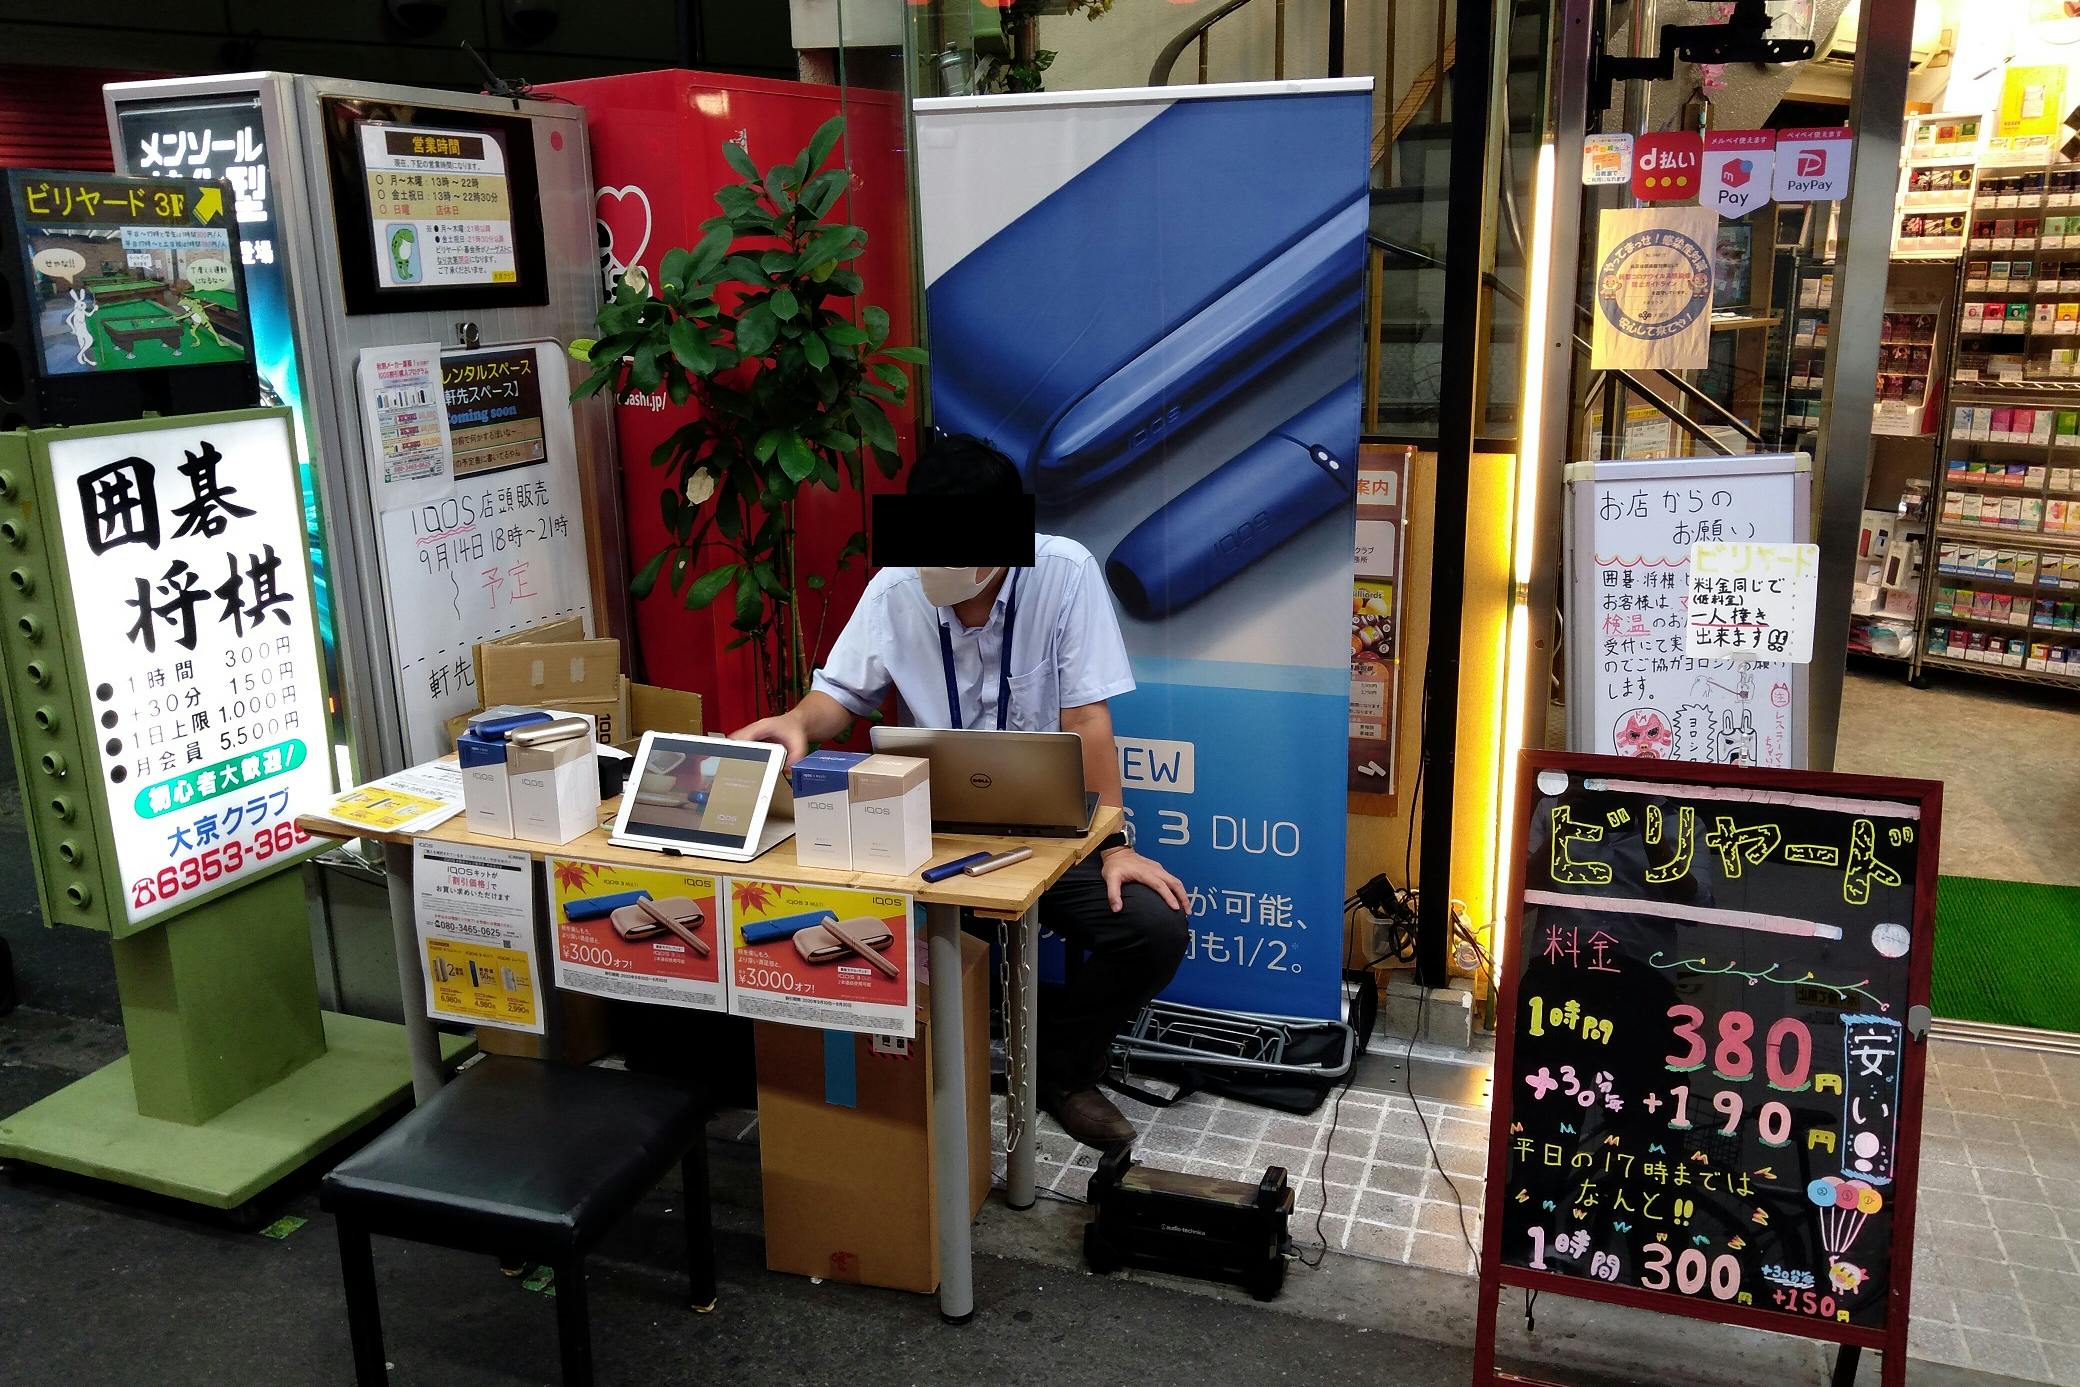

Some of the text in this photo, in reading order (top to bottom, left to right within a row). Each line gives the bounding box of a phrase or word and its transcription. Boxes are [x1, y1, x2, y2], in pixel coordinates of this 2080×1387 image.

[140, 126, 264, 168] メンソール
[412, 136, 461, 156] 営業時間
[1639, 147, 1695, 171] d払い
[1718, 189, 1749, 208] Pay
[1787, 179, 1833, 193] PayPay
[26, 184, 146, 218] ビリヤード
[153, 192, 185, 218] 3F
[440, 359, 532, 386] レンタルスペース
[490, 404, 518, 420] soon
[76, 440, 258, 557] 囲碁
[1356, 478, 1390, 496] 案内
[1672, 518, 1755, 545] お願い
[1696, 545, 1816, 577] ビリヤード
[125, 543, 295, 653] 将棋
[480, 560, 540, 609] 予定
[1693, 577, 1786, 594] 料金同じで
[1693, 595, 1744, 606] (低料金)
[1691, 606, 1769, 625] 一人撞き
[224, 635, 292, 668] 300円
[127, 659, 195, 694] 1時間
[228, 661, 294, 695] 150円
[428, 655, 475, 699] 軒先
[1607, 676, 1655, 701] します。
[129, 686, 202, 721] +30分
[132, 710, 211, 749] 1日上限
[135, 740, 204, 779] 月会員
[1116, 747, 1181, 784] EW
[472, 772, 495, 783] IQOS
[520, 777, 545, 788] IQOS
[807, 800, 835, 811] IQOS
[864, 805, 891, 816] IQOS
[167, 785, 290, 858] 大京クラブ
[1158, 809, 1191, 846] 3
[1212, 815, 1301, 858] DUO
[1551, 804, 1914, 905] ビリヤード
[447, 865, 498, 879] IQOSキットが
[684, 878, 712, 888] IQOS
[436, 885, 511, 902] お買い求めいただけます
[872, 896, 903, 907] IQOS
[440, 920, 501, 937] 080-3465-0625
[1542, 924, 1621, 974] 料金
[1528, 996, 1614, 1045] 1時間
[1512, 1136, 1755, 1197] 平日の17時までは
[1527, 1225, 1622, 1282] 1時間
